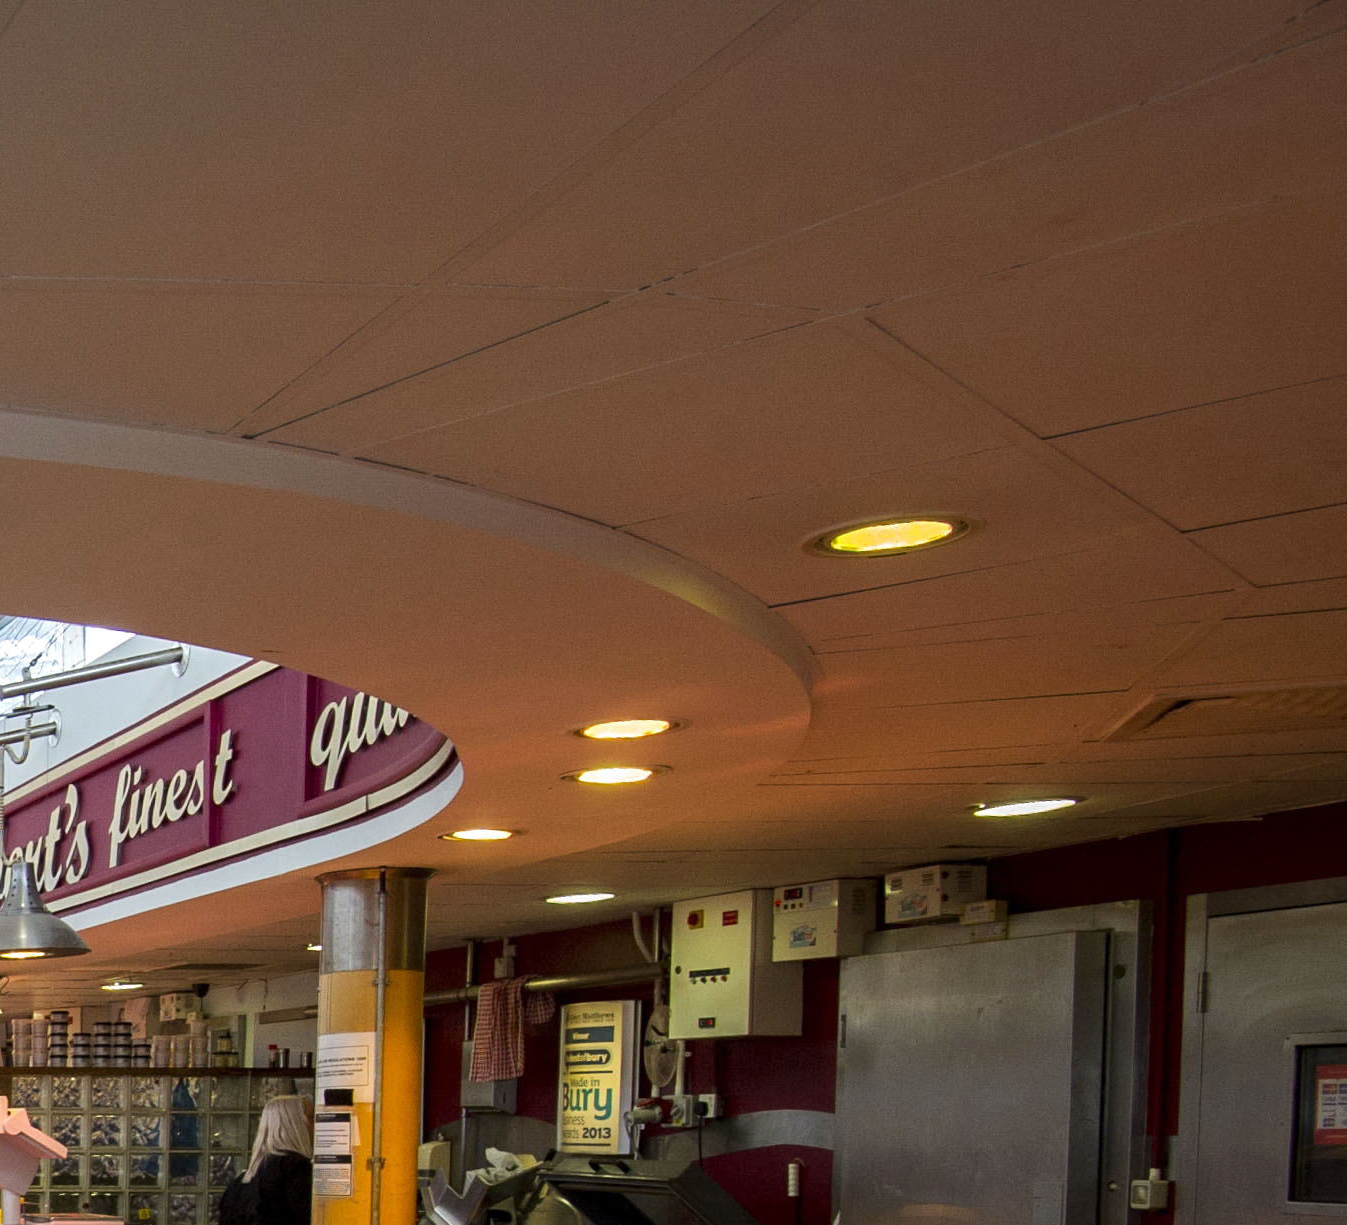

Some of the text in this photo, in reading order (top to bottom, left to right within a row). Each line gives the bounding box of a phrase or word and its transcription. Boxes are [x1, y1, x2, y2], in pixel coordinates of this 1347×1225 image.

[108, 728, 235, 868] finest
[590, 1077, 600, 1087] in
[563, 1082, 613, 1120] Bury
[582, 1127, 612, 1139] 2013
